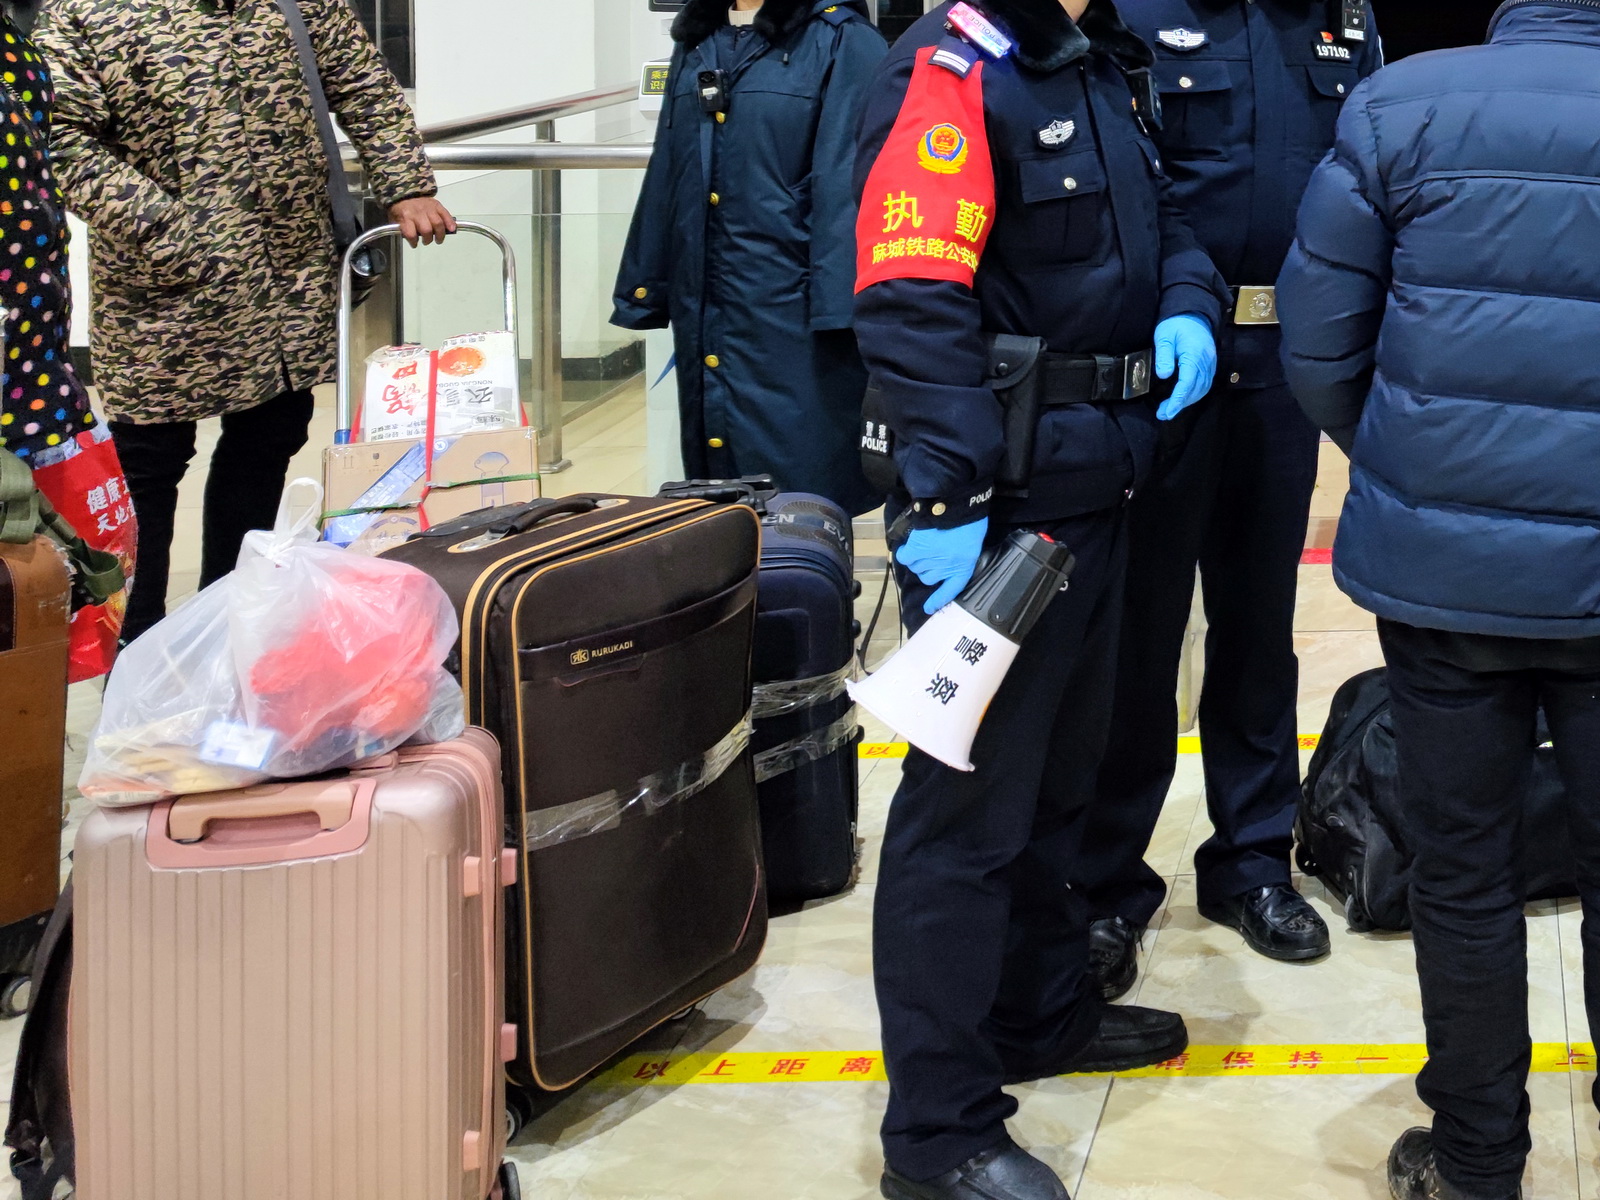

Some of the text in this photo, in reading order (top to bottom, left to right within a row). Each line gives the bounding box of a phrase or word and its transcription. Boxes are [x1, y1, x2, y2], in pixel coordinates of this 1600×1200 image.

[1316, 44, 1351, 59] 197102
[882, 190, 988, 243] 执勤
[861, 435, 888, 453] POLICE
[591, 640, 633, 658] RURUKADI
[925, 635, 988, 706] 警察
[633, 1056, 878, 1080] 以上距离
